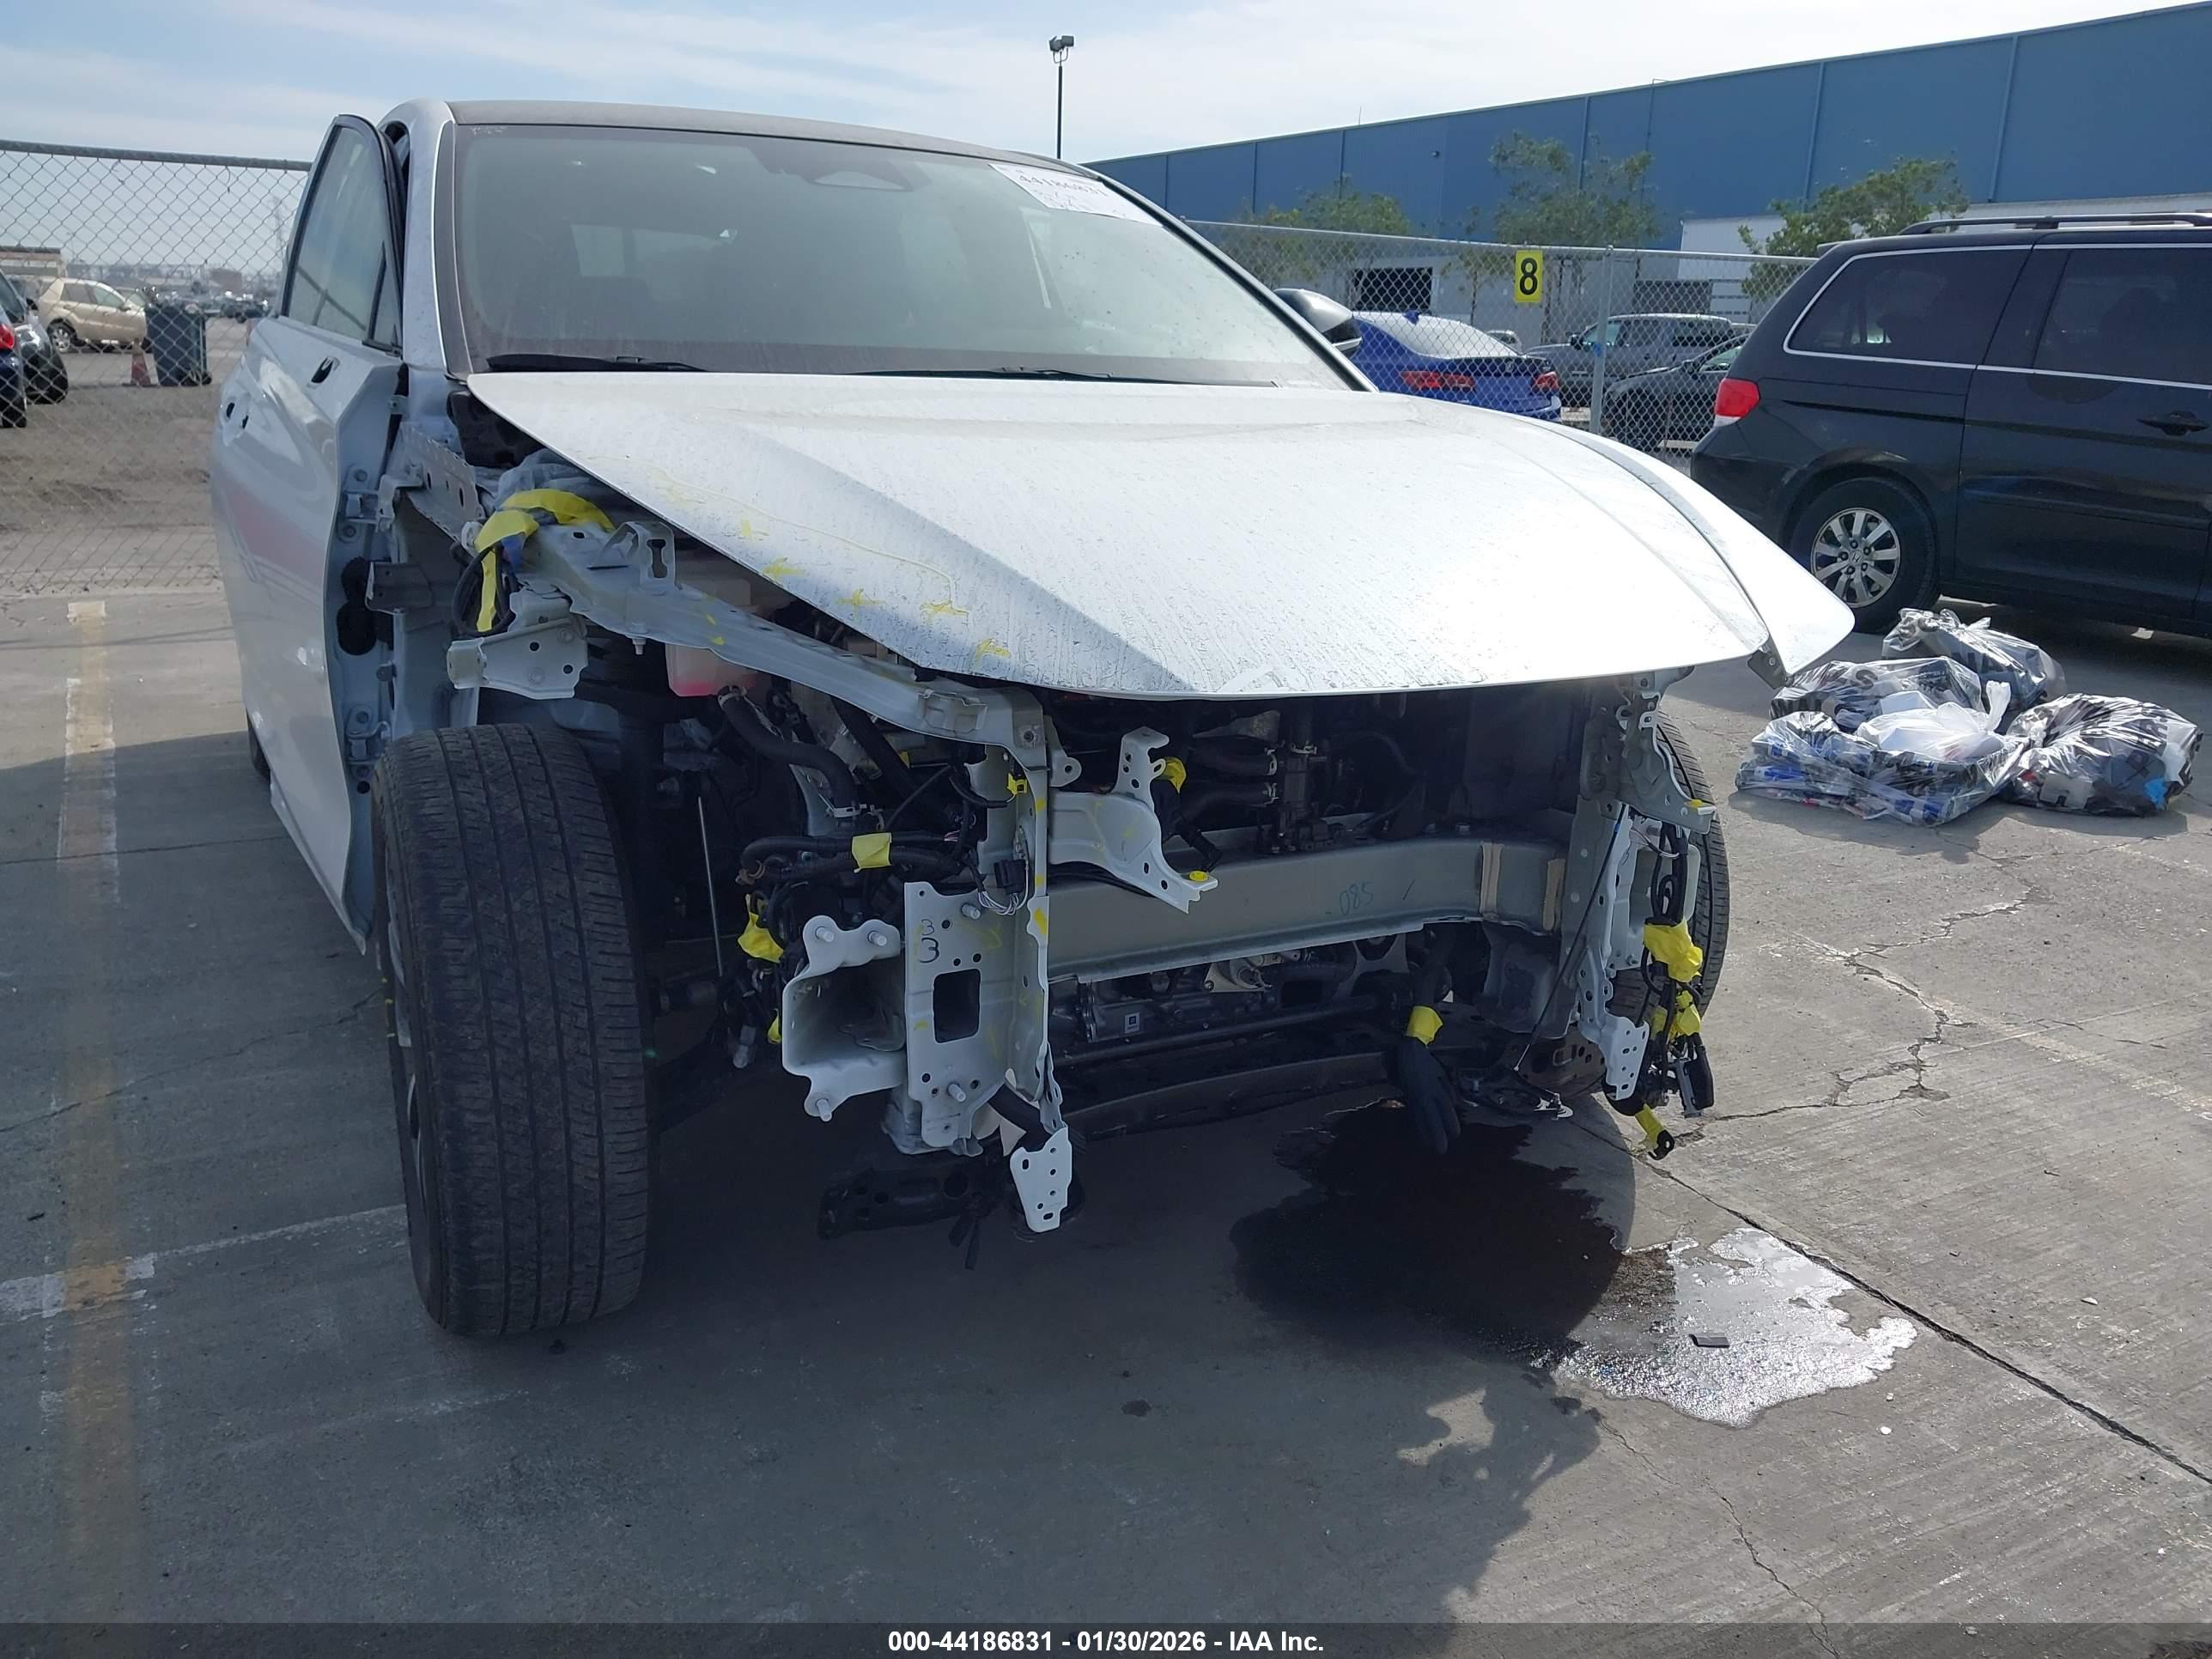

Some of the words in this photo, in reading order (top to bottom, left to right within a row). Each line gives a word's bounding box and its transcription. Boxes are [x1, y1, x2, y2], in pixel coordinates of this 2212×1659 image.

[1520, 258, 1538, 296] 8
[921, 918, 935, 936] 3
[918, 937, 940, 963] 3
